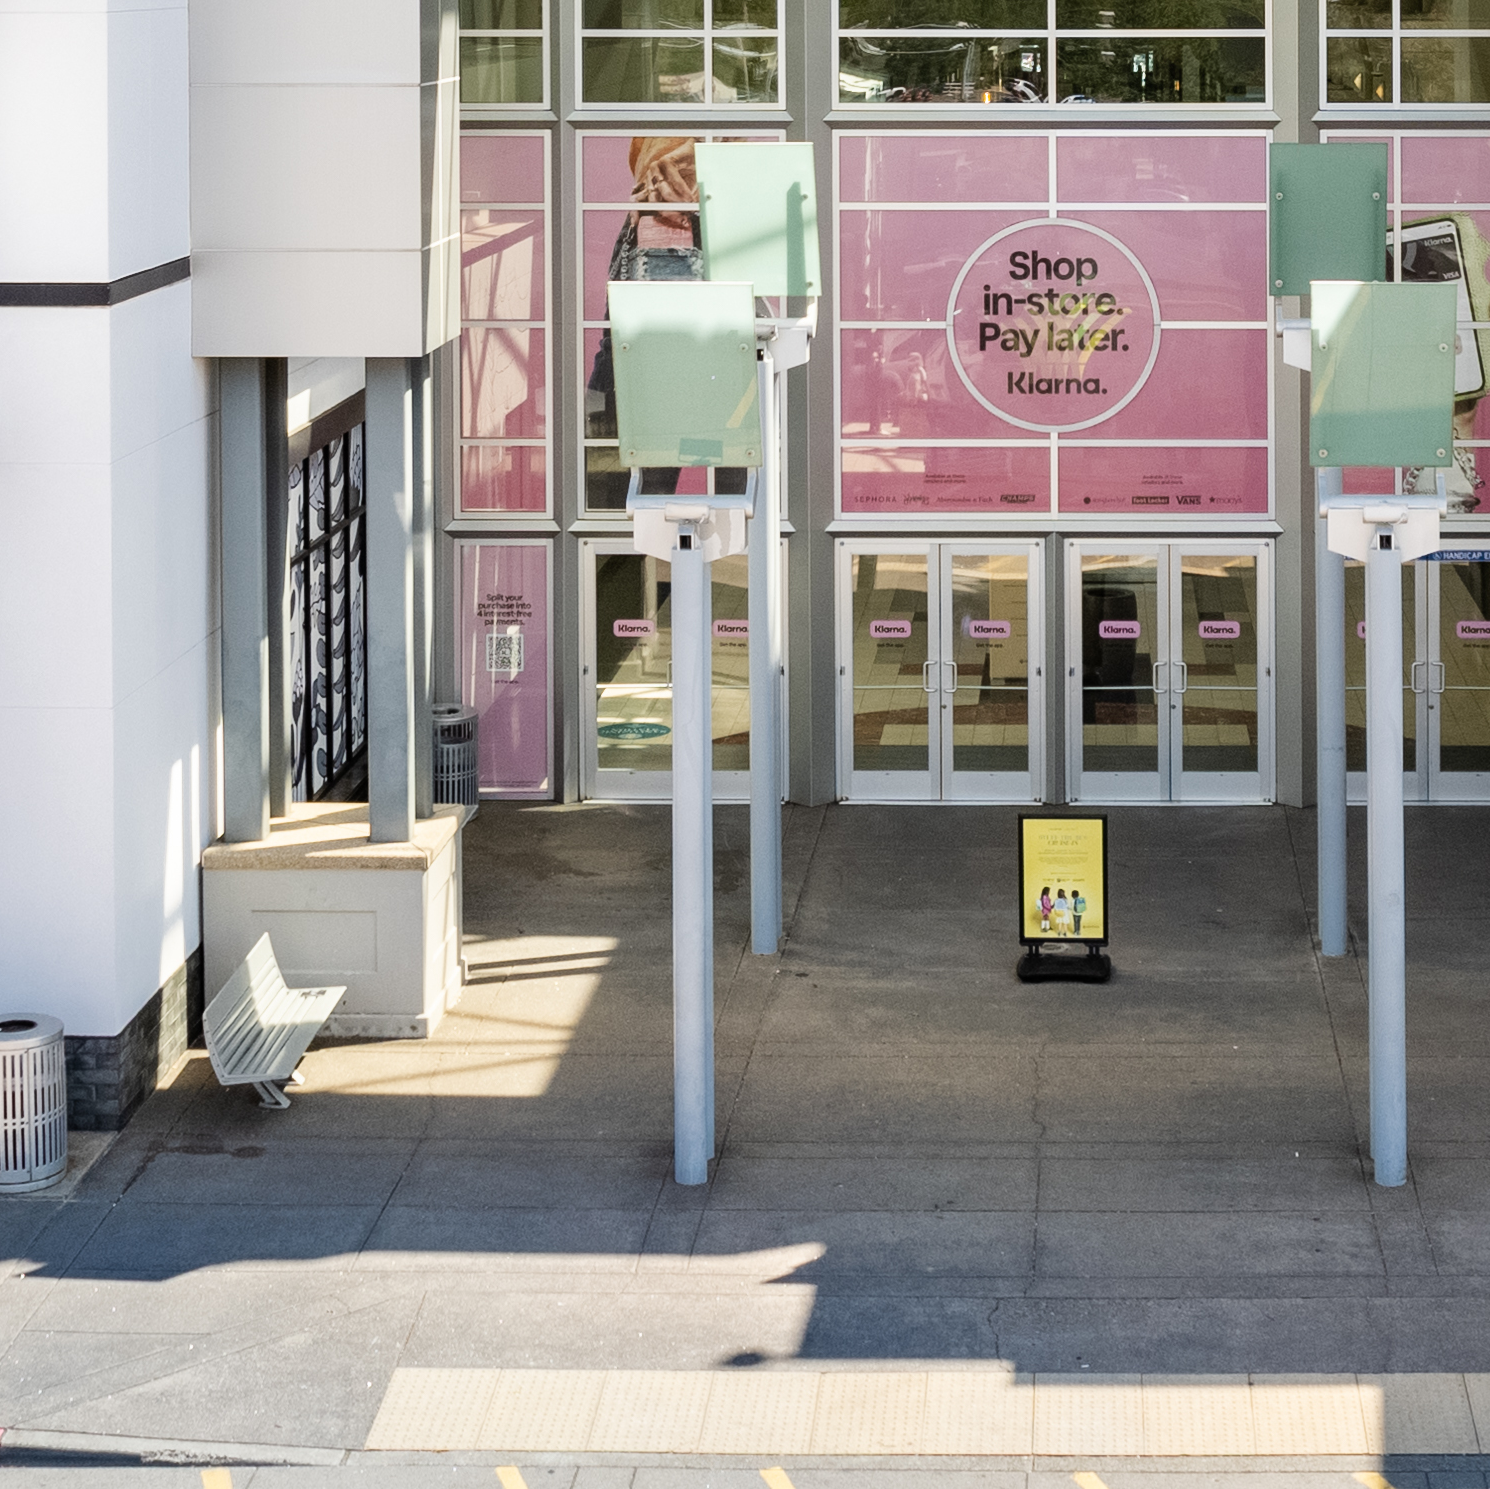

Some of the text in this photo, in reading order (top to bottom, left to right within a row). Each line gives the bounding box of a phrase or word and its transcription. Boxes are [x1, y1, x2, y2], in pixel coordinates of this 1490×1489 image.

[1423, 236, 1453, 247] Klarna.
[1009, 250, 1098, 286] Shop
[983, 284, 1124, 316] in-store.
[979, 321, 1129, 358] Pay later.
[1007, 371, 1108, 395] Klarna.
[854, 495, 897, 503] SEPHORA
[1176, 495, 1201, 505] VANS
[1443, 552, 1482, 560] HANDICAP
[486, 593, 523, 603] Split your
[478, 602, 531, 611] purchase into
[484, 618, 525, 627] payments.
[618, 624, 651, 633] Klarna.
[874, 625, 907, 633] Klarna.
[974, 625, 1007, 634] Klarna.
[1103, 626, 1137, 634] Klarna.
[1203, 626, 1236, 634] Klarna.
